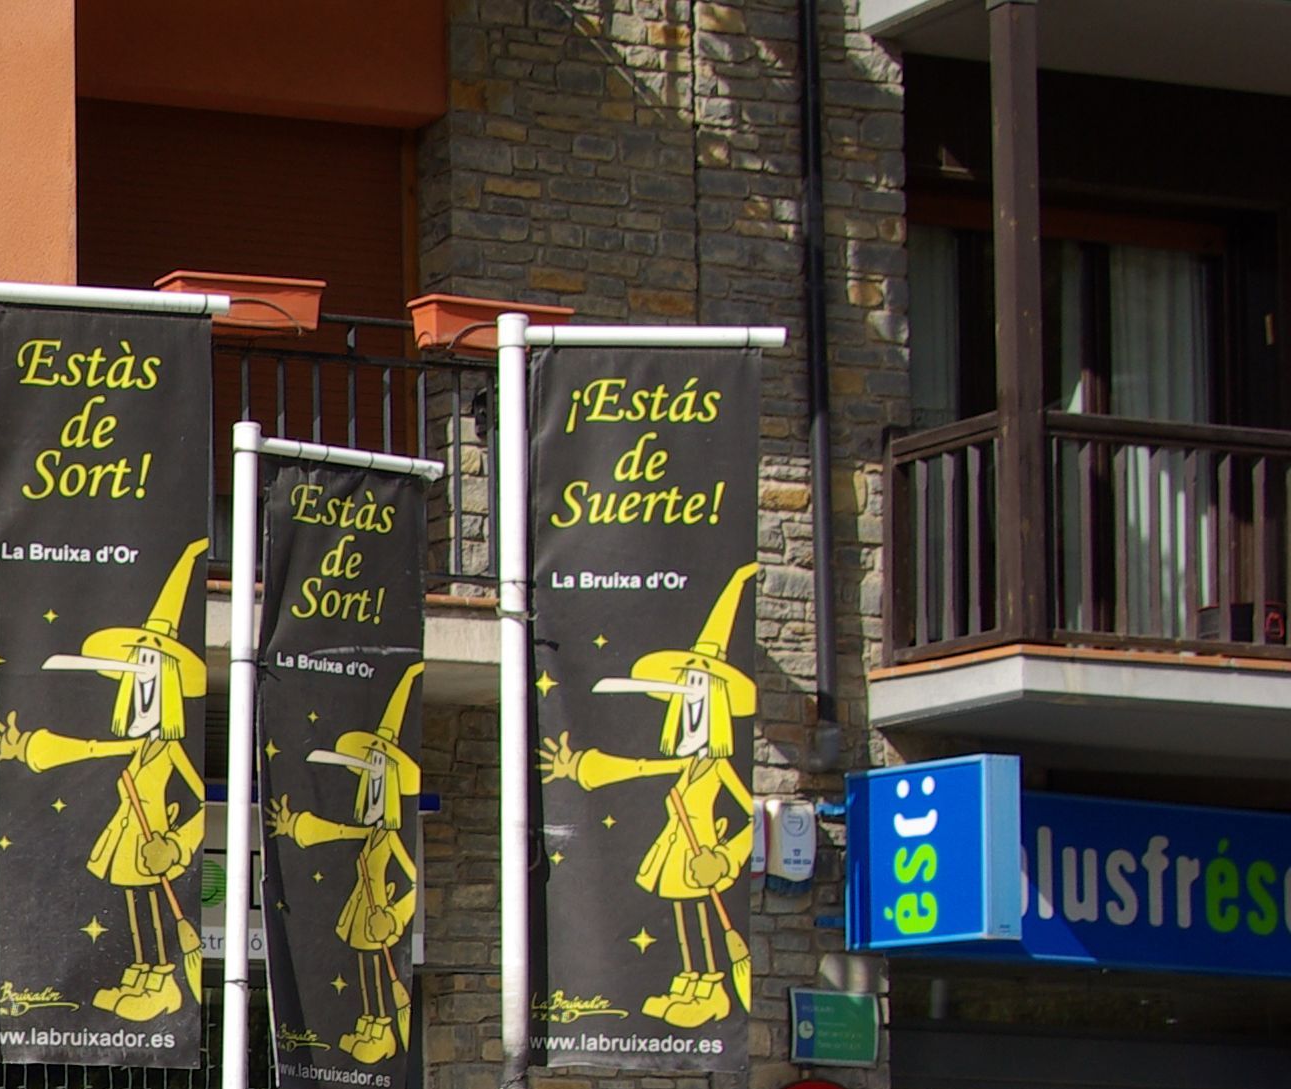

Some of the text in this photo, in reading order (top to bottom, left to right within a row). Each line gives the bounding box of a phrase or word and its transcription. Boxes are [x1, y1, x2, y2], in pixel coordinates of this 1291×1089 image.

[17, 339, 161, 389] Estàs
[60, 395, 117, 449] de
[565, 377, 722, 433] ¡Estás
[22, 450, 152, 499] Sort!
[614, 432, 668, 482] de
[291, 484, 396, 533] Estàs
[550, 480, 725, 528] Suerte!
[1, 543, 138, 563] La Bruixa d'Or
[321, 534, 362, 580] de
[291, 577, 386, 625] Sort!
[552, 572, 687, 589] La Bruixa d'Or
[276, 652, 375, 679] La Bruixa d'Or
[1021, 826, 1291, 936] lusfrés
[530, 1034, 723, 1053] www.labruixador.es
